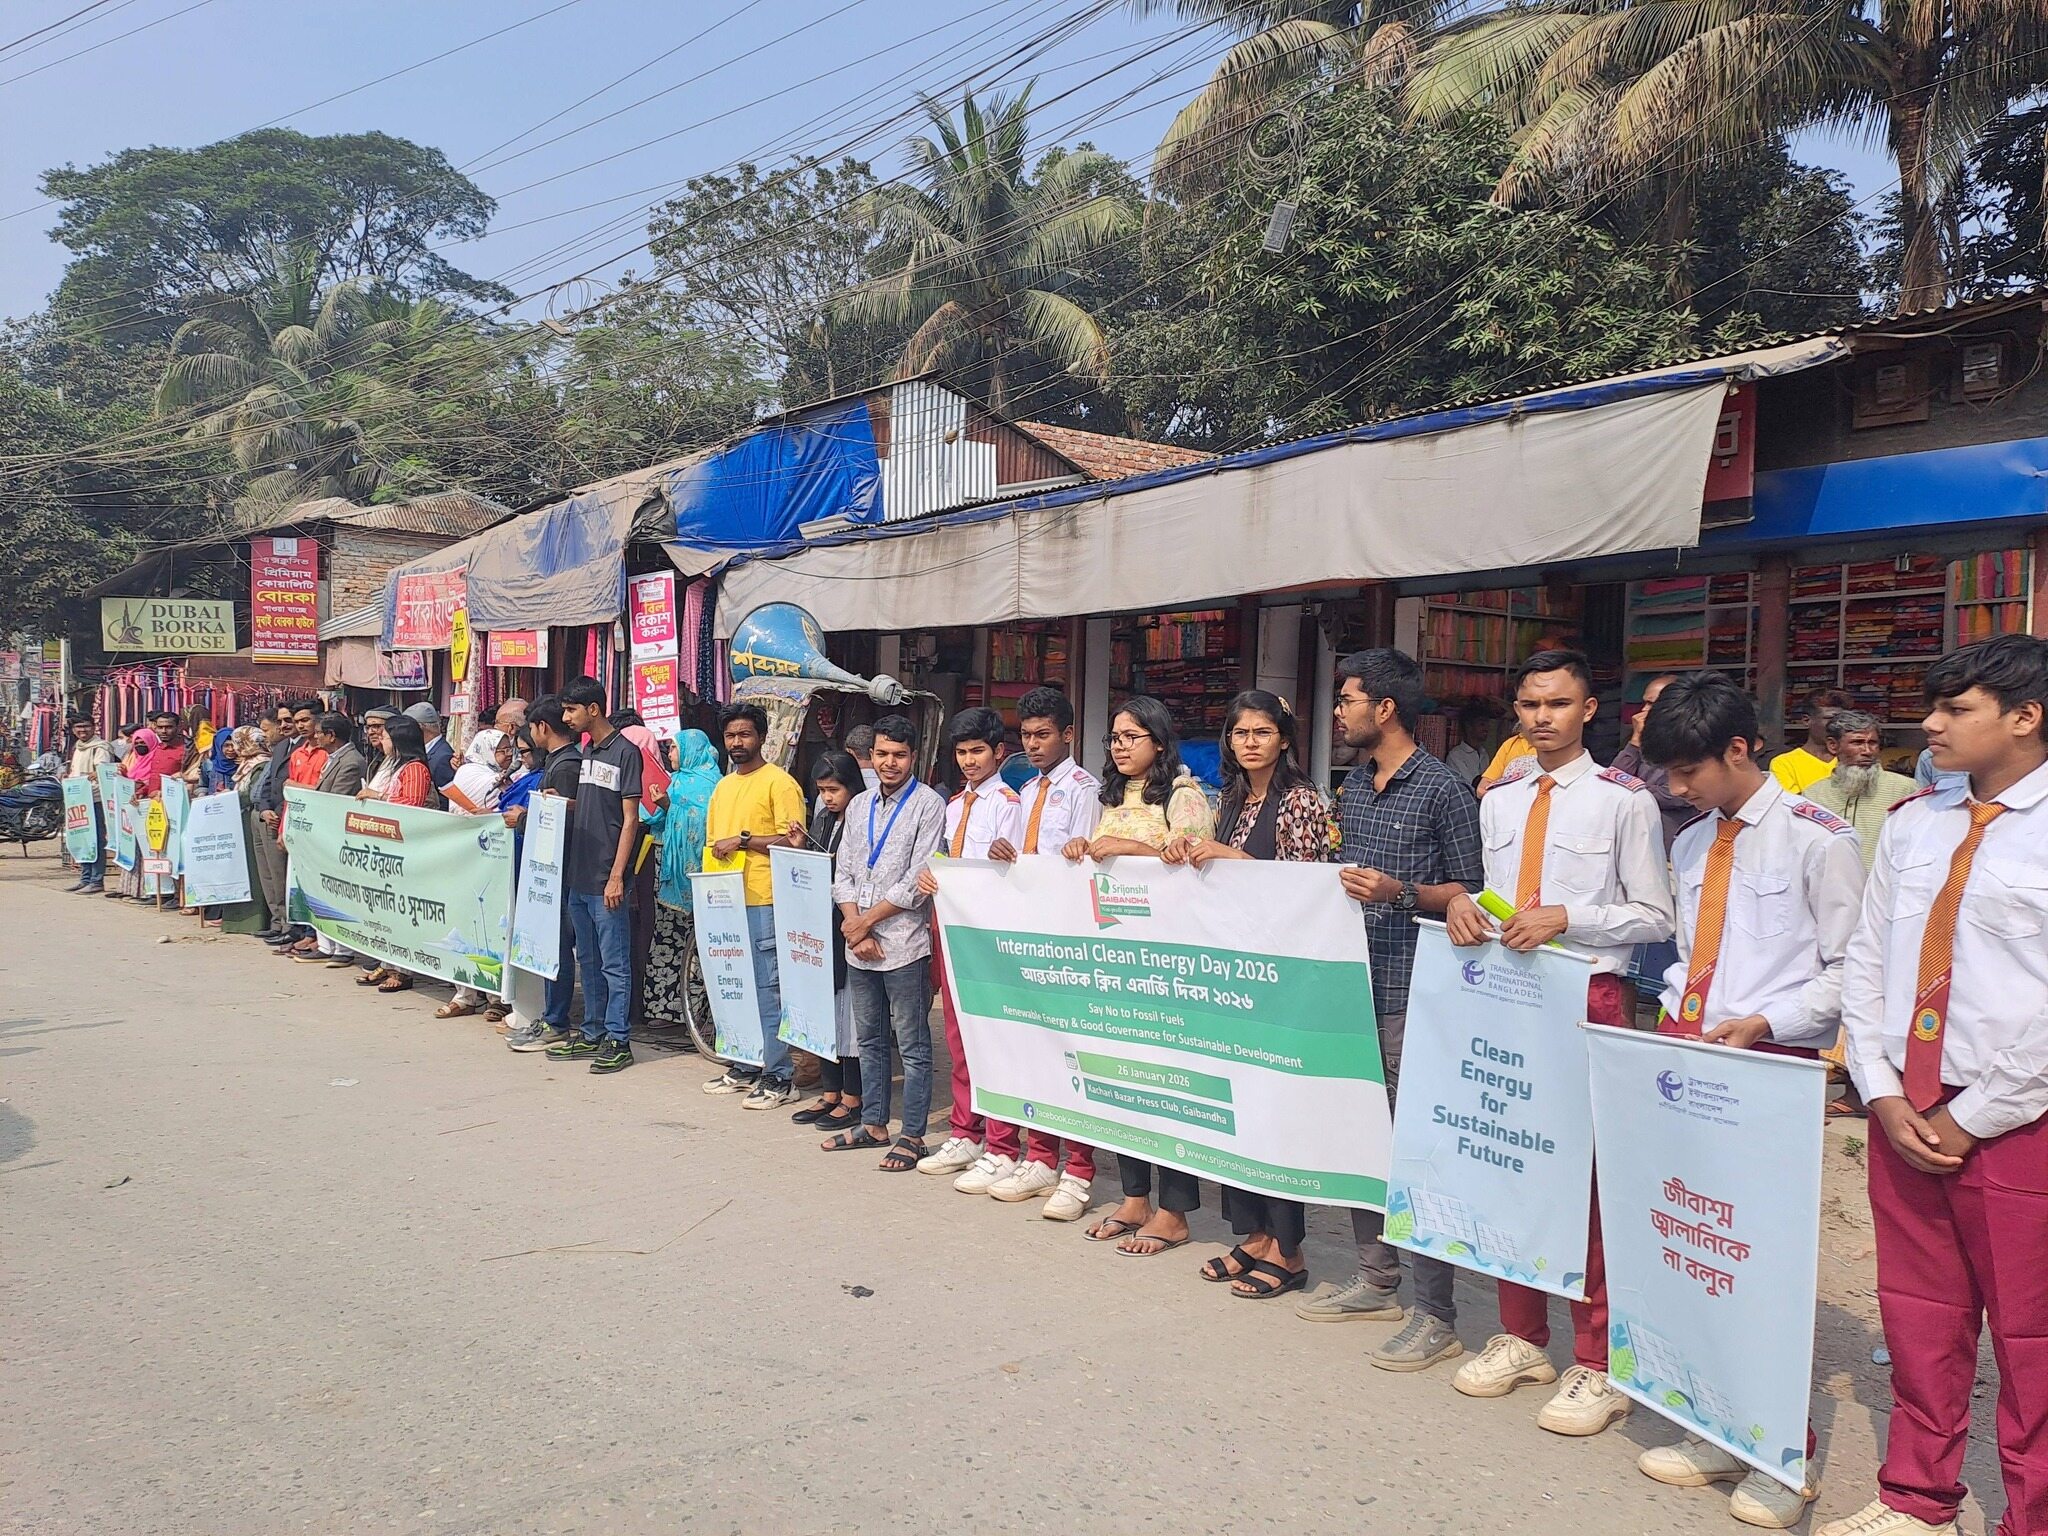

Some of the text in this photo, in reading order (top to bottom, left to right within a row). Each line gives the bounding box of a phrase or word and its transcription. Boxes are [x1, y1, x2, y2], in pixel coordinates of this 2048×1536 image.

[263, 567, 312, 579] প্রিমিয়াম
[256, 580, 315, 590] কোয়ালিটি
[256, 590, 316, 604] বোরকা
[151, 604, 221, 619] DUBAI
[643, 600, 667, 615] বিল
[152, 620, 226, 634] BORKA
[255, 614, 274, 628] দুবাই
[273, 615, 295, 627] বোরকা
[635, 611, 671, 629] বিকাশ
[640, 624, 668, 638] করুন
[153, 635, 225, 649] HOUSE
[339, 843, 404, 879] টেকসই উন্নয়নে
[1112, 884, 1148, 896] Srijonshil
[320, 873, 446, 927] নবায়নযোগ্য জ্বালানি ও সুশাসন
[1100, 895, 1149, 904] GAIBANDHA
[708, 932, 721, 945] Say
[722, 932, 732, 942] No
[787, 930, 797, 944] চাই
[370, 935, 388, 953] কমিটি
[413, 948, 442, 970] গাইবান্ধা
[708, 946, 744, 959] Corruption
[790, 949, 810, 964] জ্বালানি
[996, 937, 1279, 983] International Clean Energy Day 2026
[725, 960, 732, 971] in
[1490, 964, 1542, 981] TRANSPARENCY
[718, 975, 743, 988] Energy
[1020, 965, 1254, 1010] আন্তর্জাতিক ক্লিন এনার্জি দিবস ২০২৬
[1488, 981, 1543, 1000] BANGLADESH
[1489, 973, 1543, 991] INTERNATIONAL
[721, 989, 744, 1000] Sector
[1088, 1003, 1185, 1027] Say No to Fossil Fuels
[1003, 1005, 1303, 1069] Renewable Energy & Good Governance for Sustainable Development
[1471, 1037, 1524, 1068] Clean
[1117, 1064, 1191, 1088] 26 January 2026
[1461, 1060, 1532, 1101] Energy
[1087, 1084, 1227, 1125] Kachari Bazar Press Club, Gaibandha
[1480, 1091, 1508, 1116] for
[1432, 1104, 1555, 1154] Sustainable
[1457, 1136, 1524, 1173] Future
[1187, 1149, 1321, 1189] www.srijonshilgaibandha.org
[1662, 1176, 1734, 1229] জীবাশ্ম
[1650, 1208, 1751, 1262] জ্বালানিকে
[1662, 1246, 1735, 1298] না বলুন
